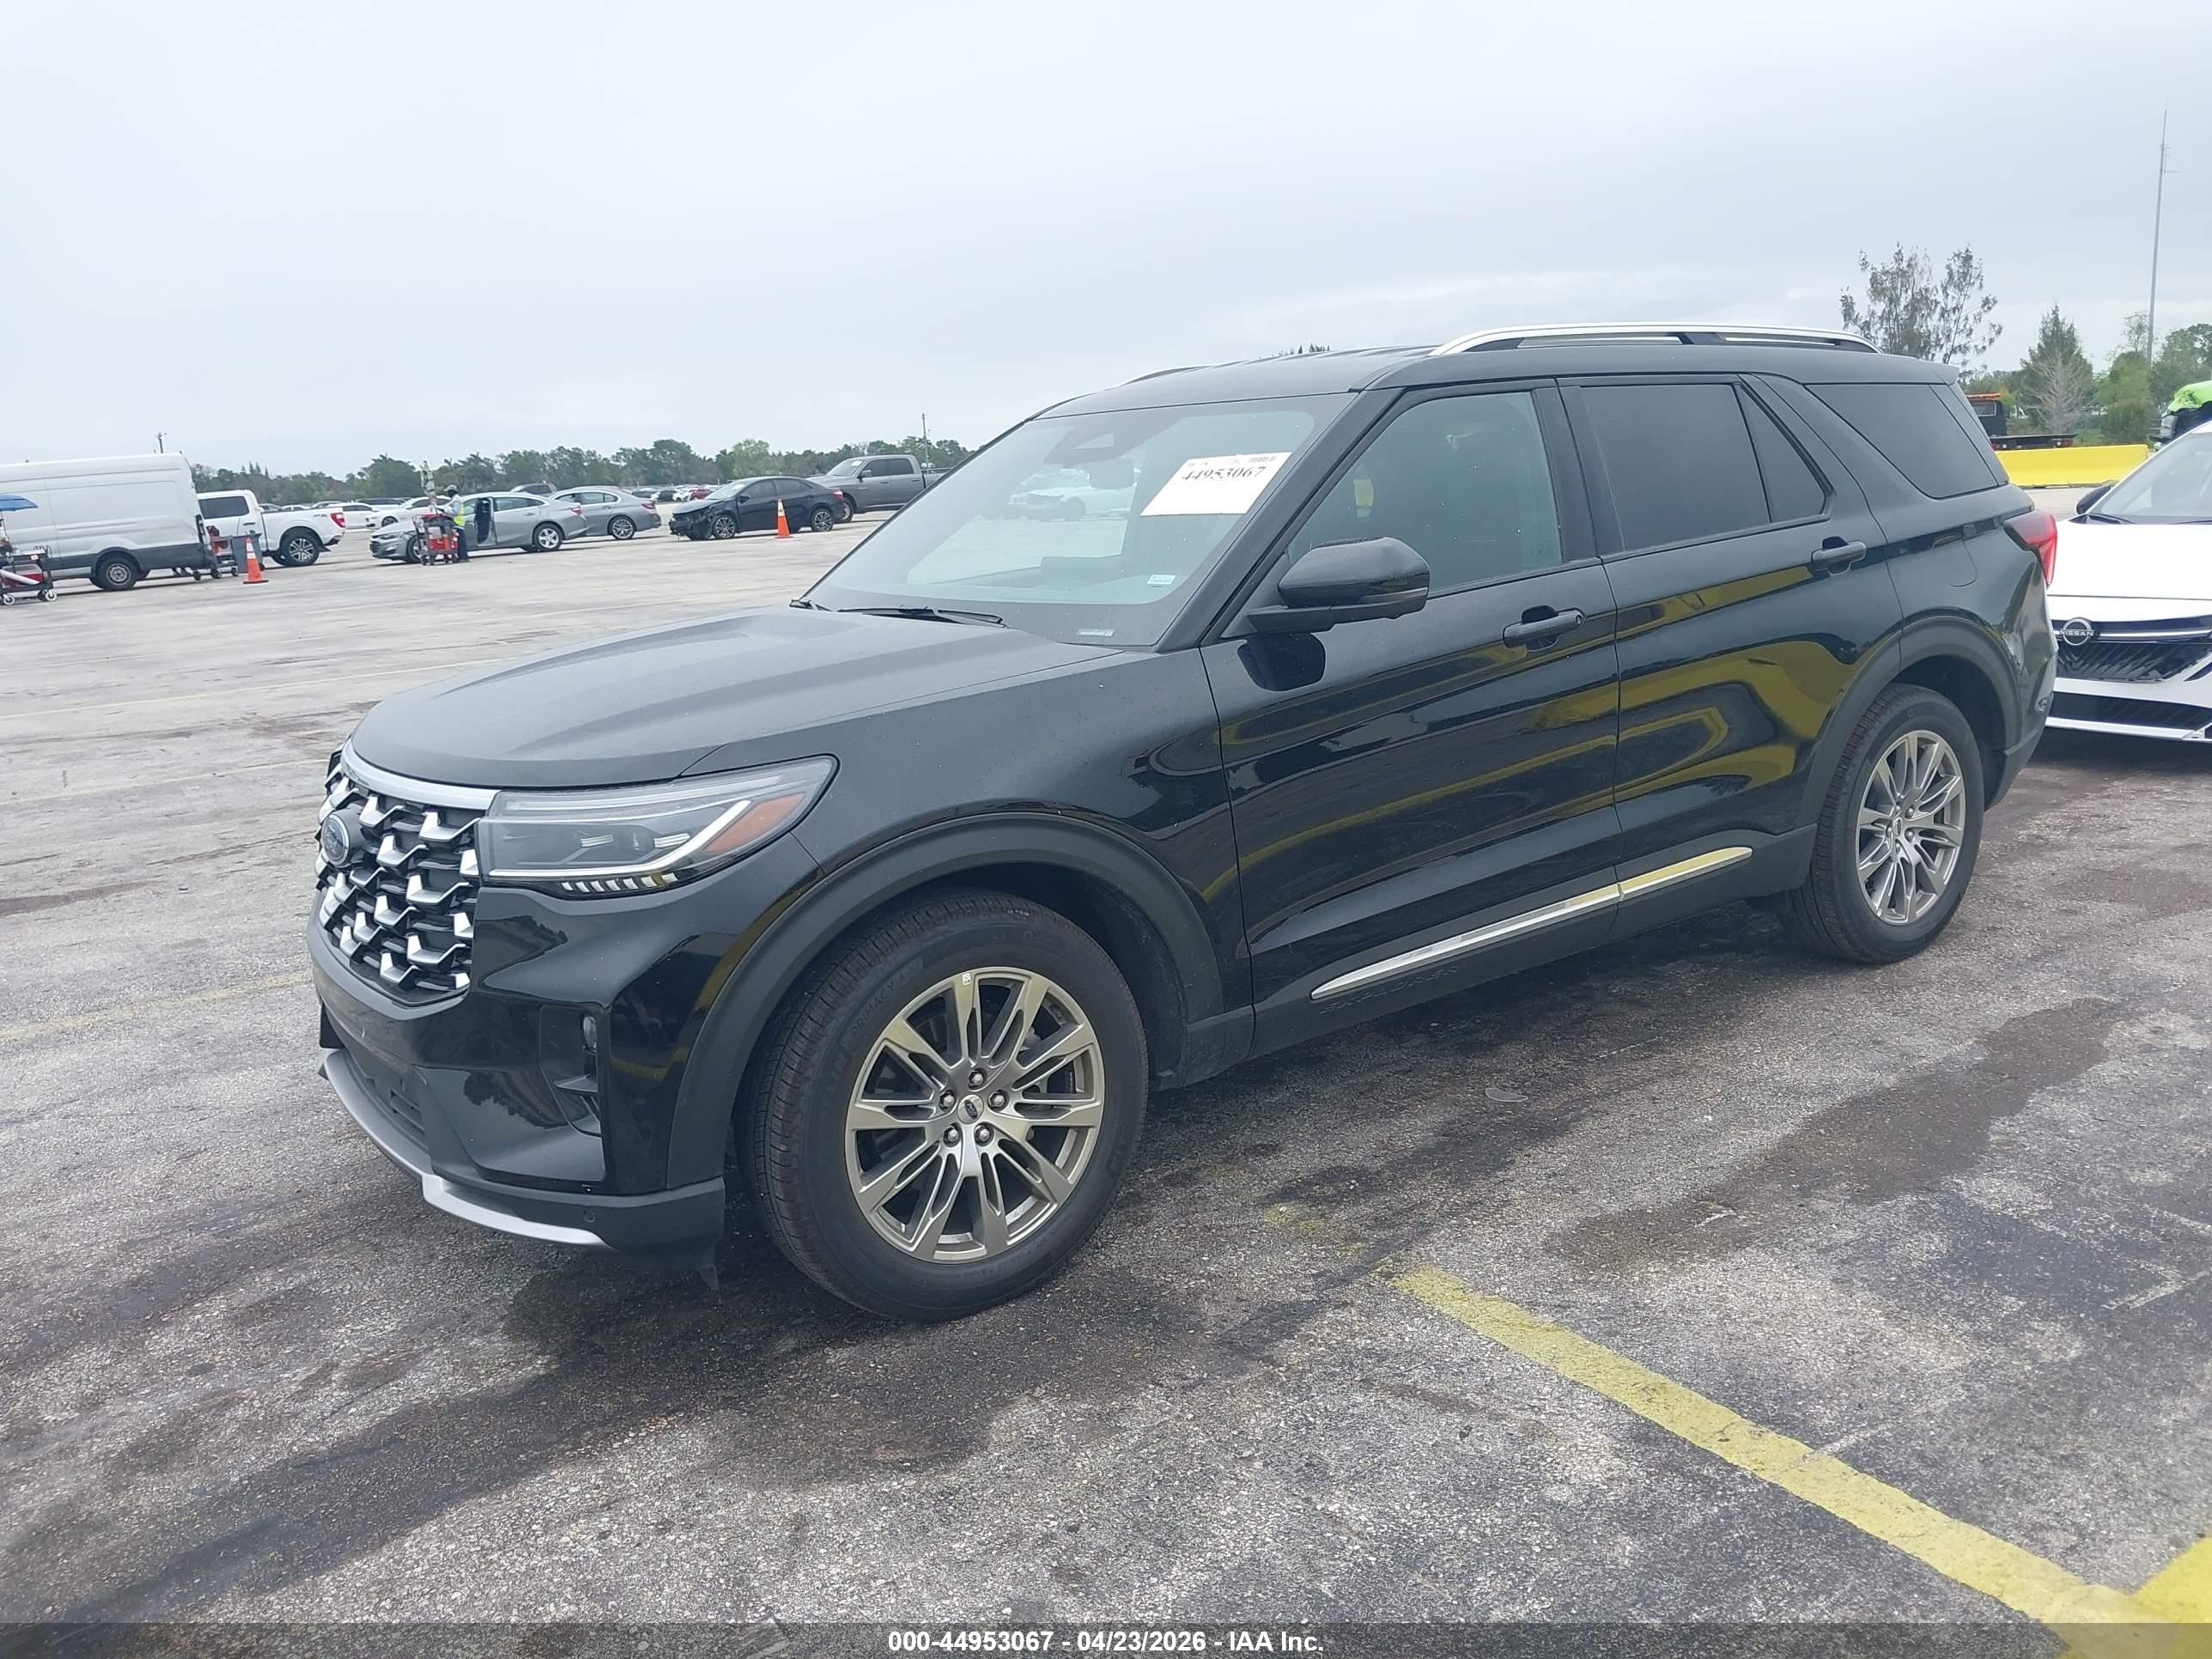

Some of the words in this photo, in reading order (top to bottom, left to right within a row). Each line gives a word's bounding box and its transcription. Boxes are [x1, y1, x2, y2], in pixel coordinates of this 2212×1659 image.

[1182, 465, 1267, 481] 44953067
[2061, 629, 2094, 637] NISSAN
[1319, 964, 1460, 1015] EXPLORER
